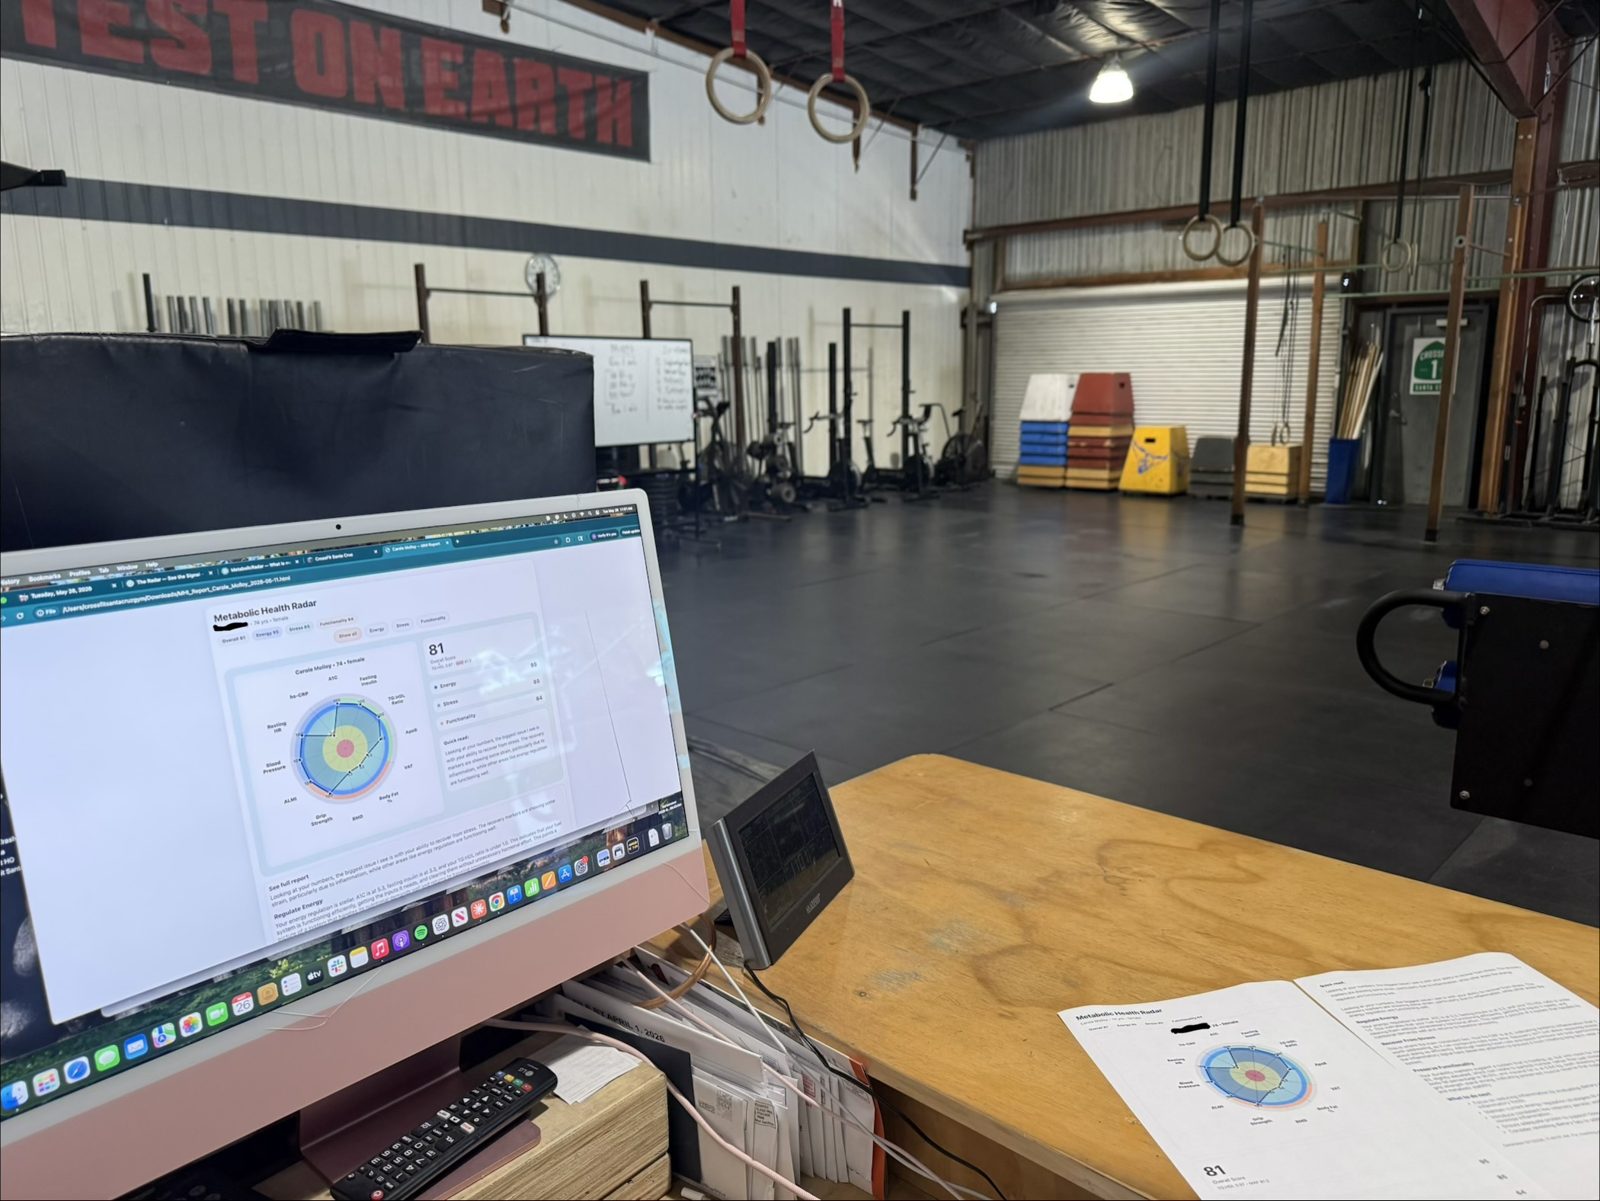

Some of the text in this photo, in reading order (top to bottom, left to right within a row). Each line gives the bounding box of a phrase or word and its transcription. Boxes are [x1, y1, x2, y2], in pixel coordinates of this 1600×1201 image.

[290, 12, 405, 110] ON
[421, 36, 633, 148] EARTH
[1431, 359, 1438, 379] 1
[28, 573, 60, 582] Bookmarks
[213, 600, 316, 622] Metabolic Health Radar
[420, 615, 445, 623] Functionality
[429, 643, 444, 656] 81
[446, 713, 476, 724] Functionality
[267, 721, 287, 729] Resting
[263, 766, 286, 774] Pressure
[311, 817, 333, 826] Strength
[270, 890, 291, 900] Looking
[298, 884, 310, 892] your
[310, 876, 334, 886] numbers,
[344, 865, 362, 875] biggest
[415, 842, 429, 850] ability
[435, 835, 451, 843] recover
[486, 816, 504, 826] recovery
[271, 899, 288, 907] strain,
[288, 888, 317, 902] particularly
[335, 871, 368, 885] inflammation,
[417, 848, 432, 856] energy
[433, 840, 454, 850] regulation
[463, 828, 486, 840] functioning
[290, 873, 308, 884] report
[273, 898, 323, 919] Regulate Energy
[236, 1000, 251, 1012] 26
[1076, 1012, 1114, 1021] Metabolic
[1203, 1165, 1226, 1176] 81
